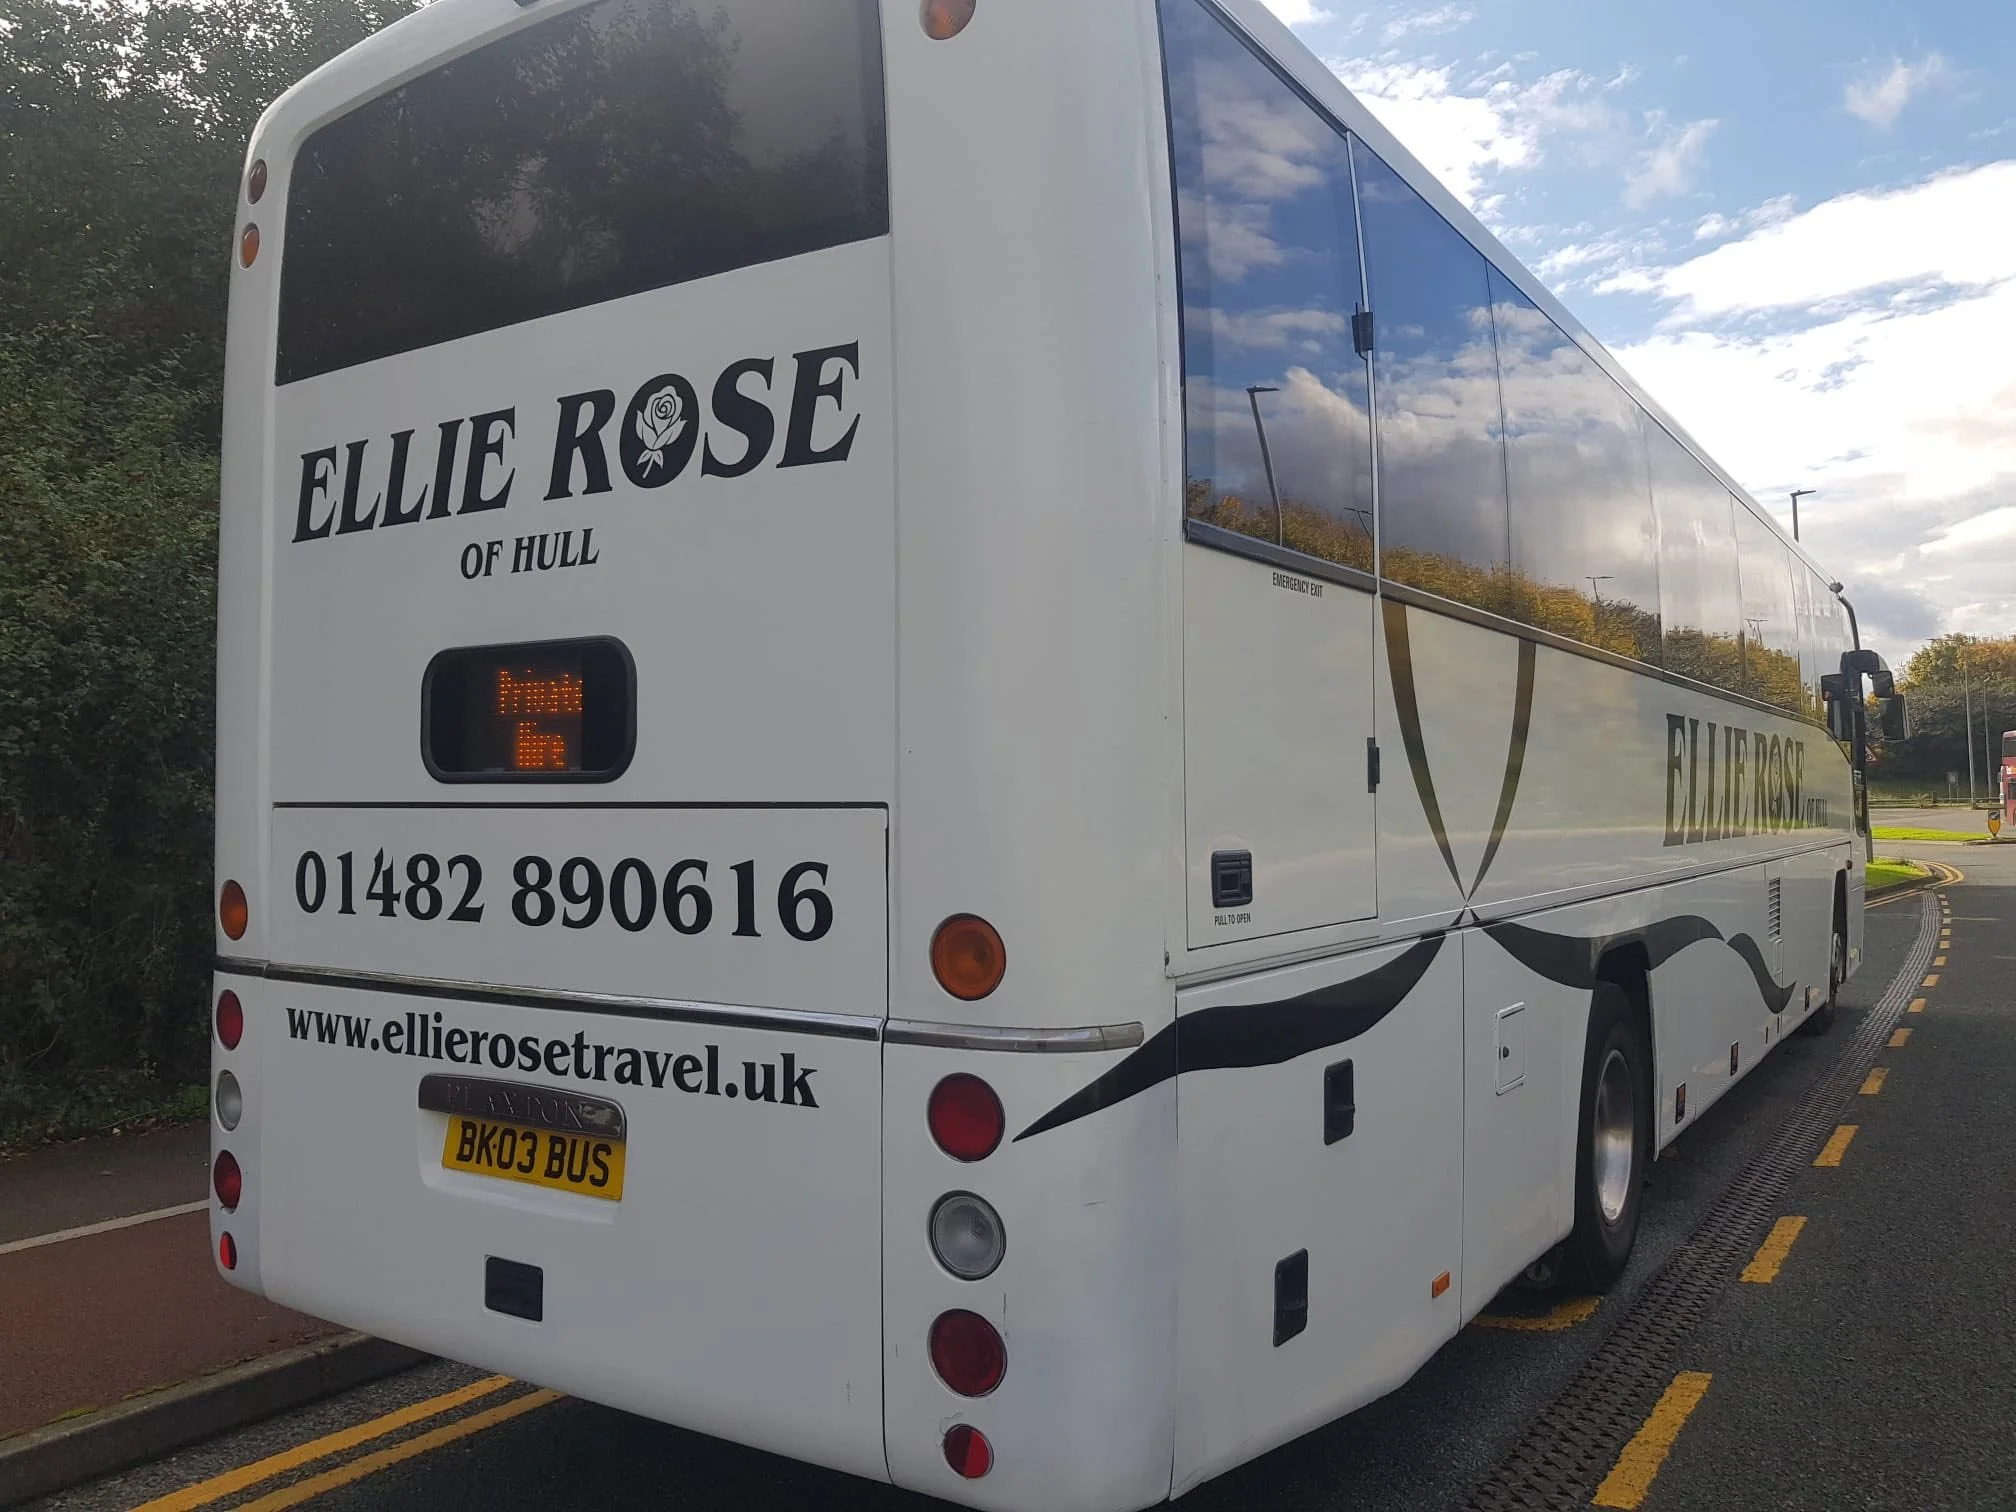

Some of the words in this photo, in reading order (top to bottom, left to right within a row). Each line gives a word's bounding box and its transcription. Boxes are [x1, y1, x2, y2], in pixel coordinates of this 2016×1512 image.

[292, 406, 517, 544] ELLIE
[543, 339, 861, 501] ROSE
[460, 540, 503, 580] OF
[511, 528, 600, 574] HULL
[1272, 571, 1310, 594] EMERGENCY
[1310, 582, 1323, 598] EXIT
[1663, 713, 1748, 847] ELLIE
[1752, 732, 1805, 836] ROSE
[295, 847, 485, 924] 01482
[511, 855, 834, 942] 890616
[1214, 915, 1228, 926] PULL
[1228, 913, 1236, 925] TO
[1236, 911, 1252, 924] OPEN
[286, 1007, 820, 1109] www.ellierosetravel.uk
[455, 1120, 538, 1174] BK03
[543, 1135, 613, 1188] BUS
